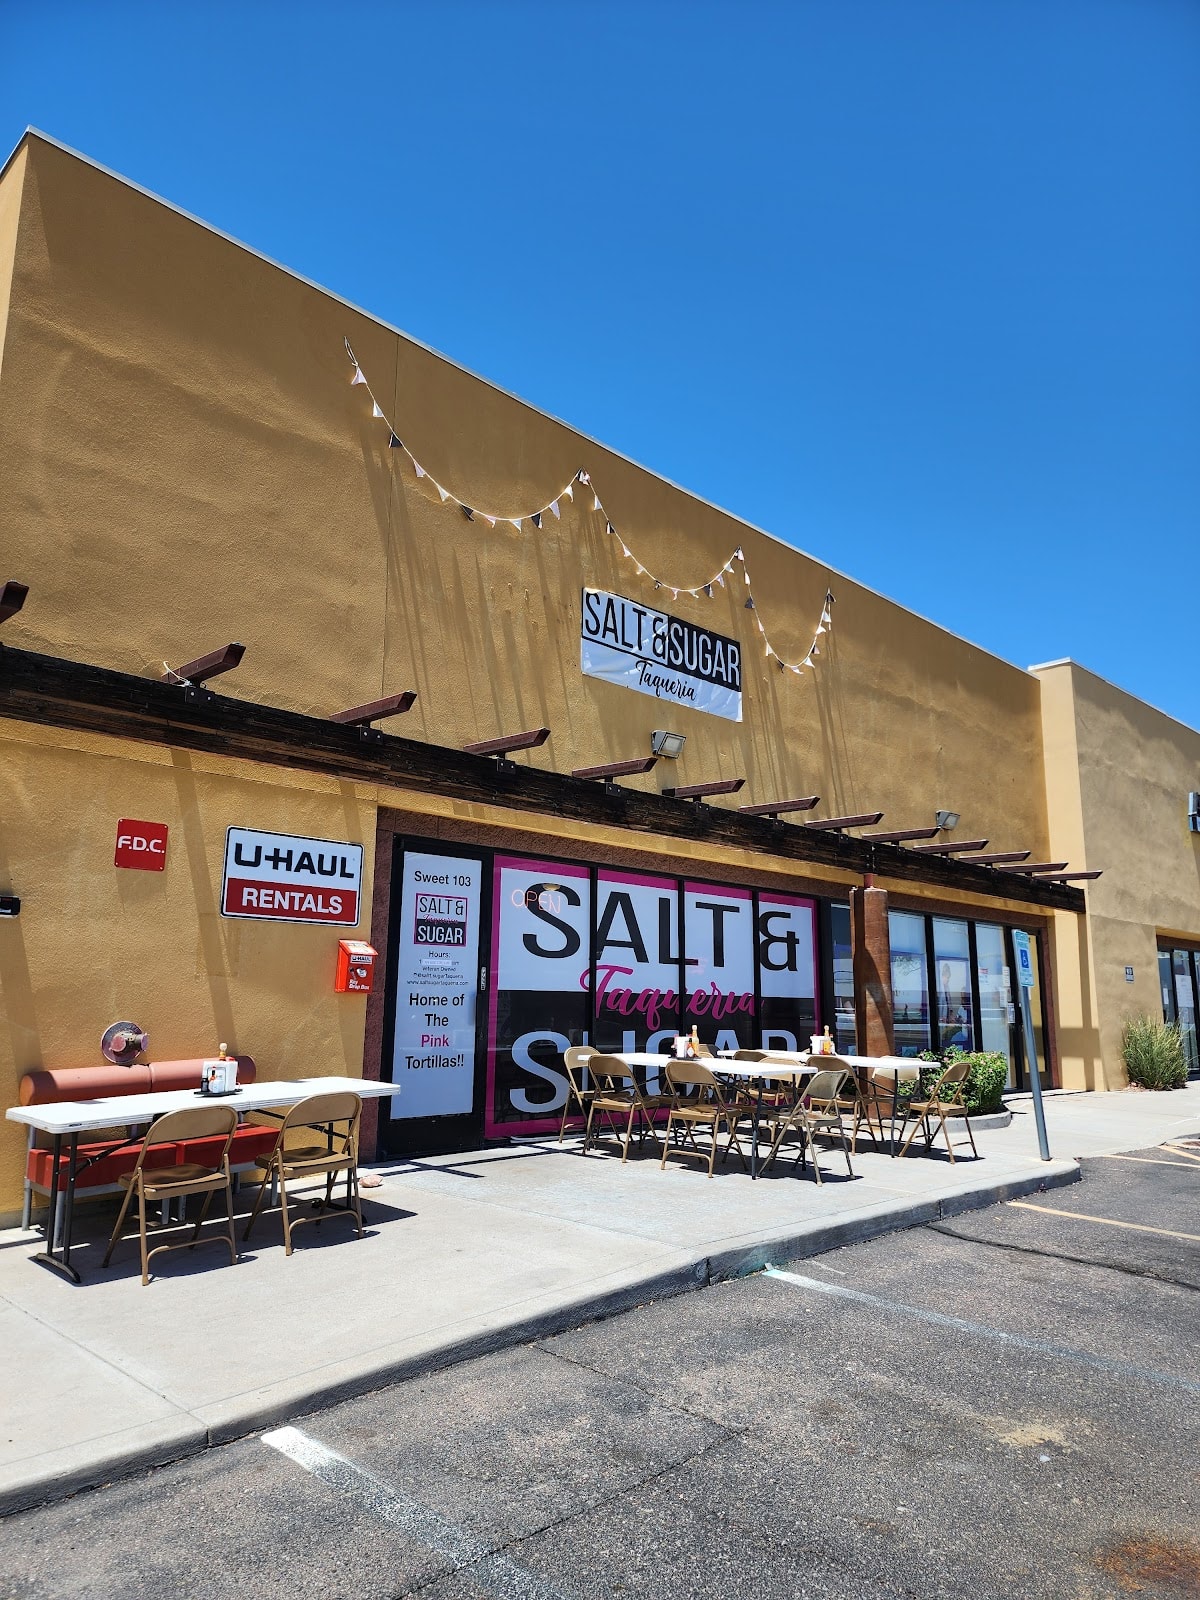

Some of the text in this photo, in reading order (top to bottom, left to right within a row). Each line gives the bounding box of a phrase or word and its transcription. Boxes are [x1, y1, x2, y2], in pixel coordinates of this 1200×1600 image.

[585, 592, 740, 686] SALT & SUGAR
[635, 660, 697, 700] Taqueria
[117, 835, 165, 854] F.D.C.
[234, 842, 355, 879] U-HAUL
[414, 870, 471, 887] Sweet 103
[242, 887, 343, 914] RENTALS
[419, 897, 464, 915] SALT &
[511, 889, 561, 913] OPEN
[417, 925, 463, 944] SUGAR
[523, 883, 800, 972] SALT &
[409, 993, 465, 1006] Home of
[579, 964, 765, 1031] Taqueria
[425, 1013, 449, 1027] The
[421, 1034, 449, 1047] Pink
[405, 1054, 464, 1069] Tortillas!!
